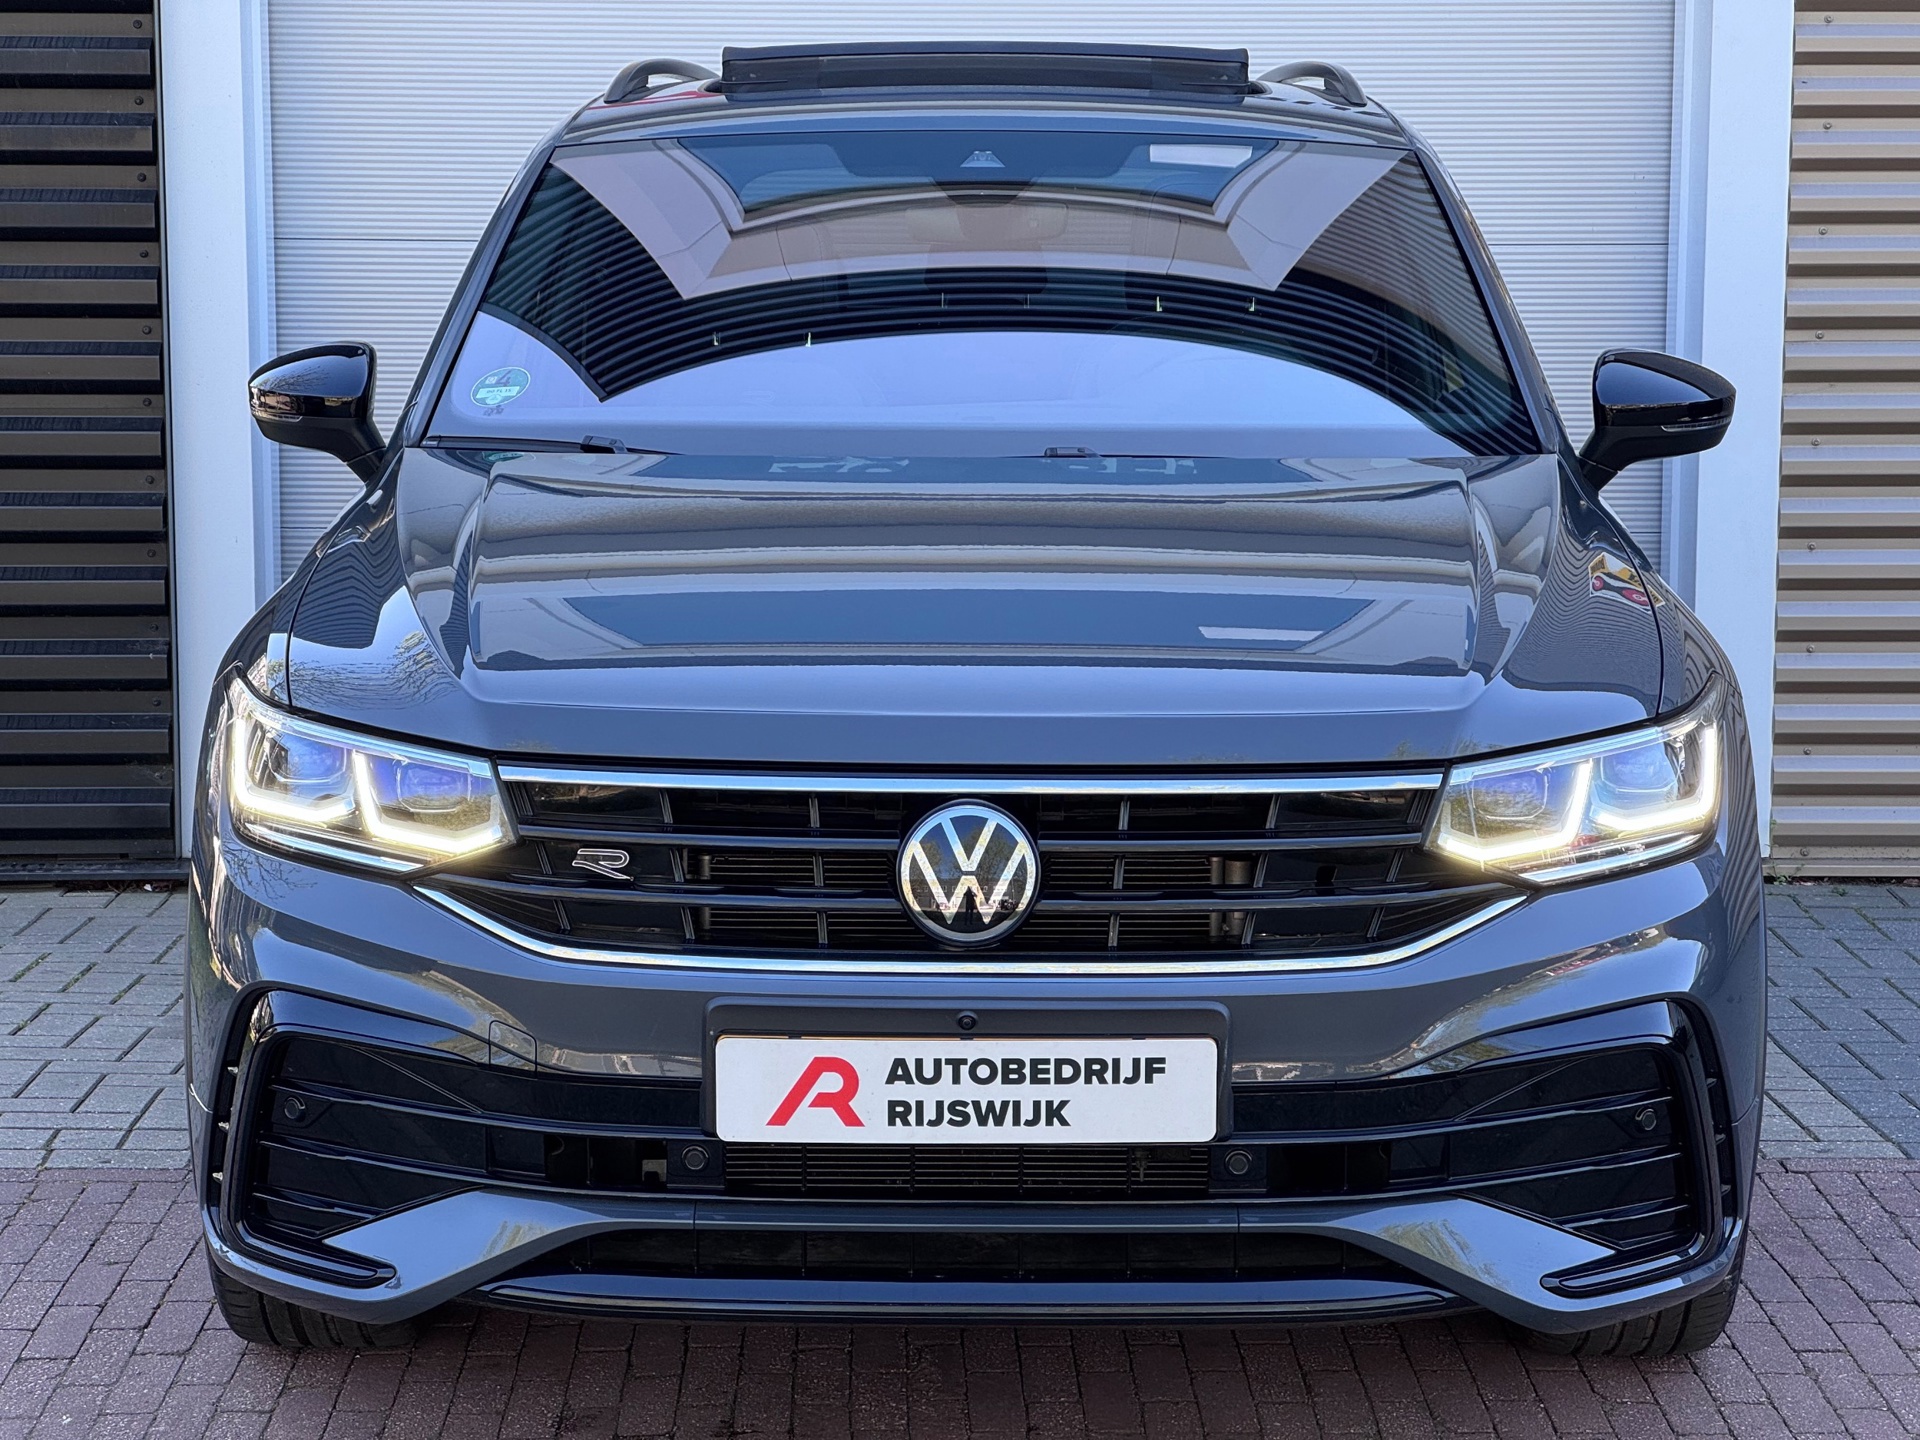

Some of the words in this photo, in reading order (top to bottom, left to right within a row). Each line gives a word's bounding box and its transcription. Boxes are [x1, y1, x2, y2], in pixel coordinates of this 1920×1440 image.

[495, 370, 512, 386] 4
[572, 848, 632, 881] R
[903, 806, 1034, 937] VW
[885, 1057, 1167, 1085] AUTOBEDRIJF
[887, 1099, 1071, 1127] RIJSWIJK
